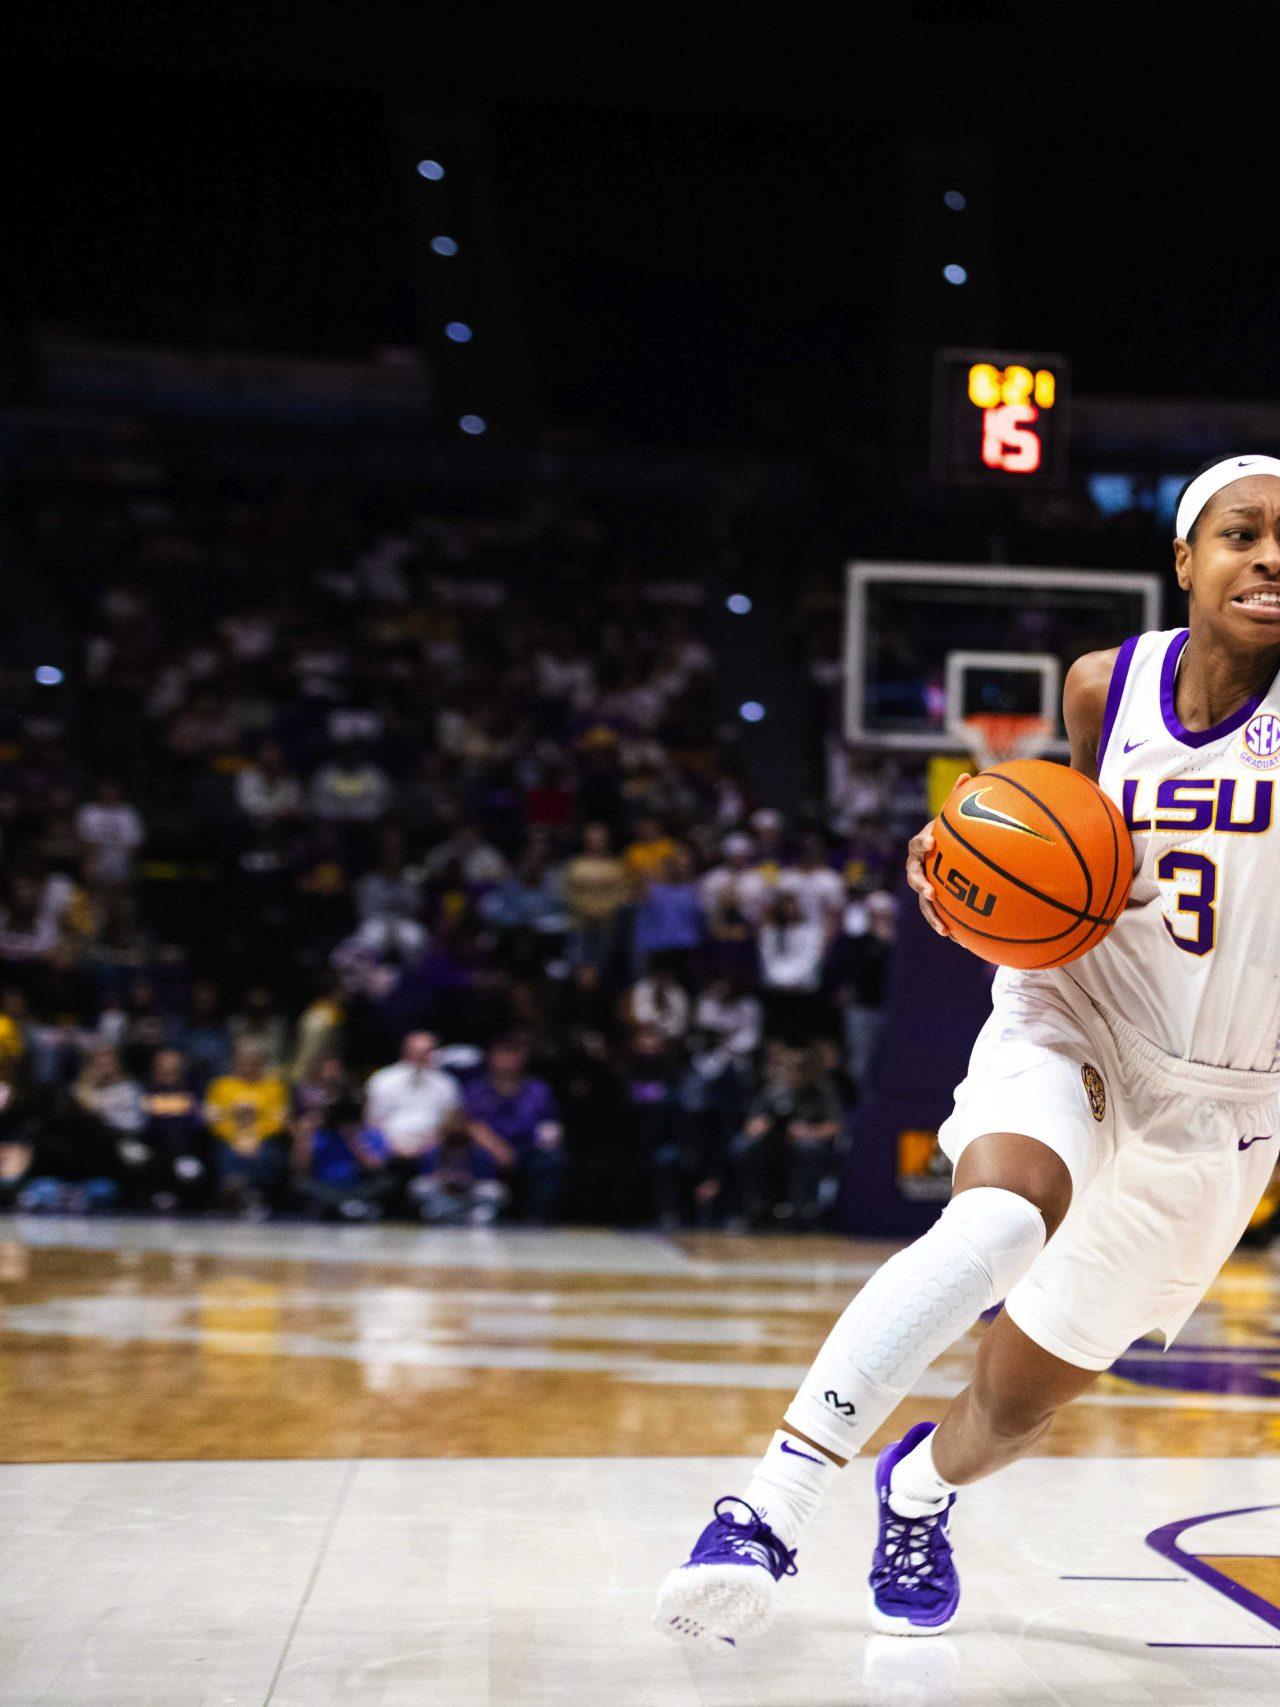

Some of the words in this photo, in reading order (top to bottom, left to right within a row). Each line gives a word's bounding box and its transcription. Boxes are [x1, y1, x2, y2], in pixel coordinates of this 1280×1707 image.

[982, 405, 1041, 473] 15
[1122, 778, 1276, 835] LSU
[933, 850, 998, 917] LSU
[1155, 850, 1218, 957] 3
